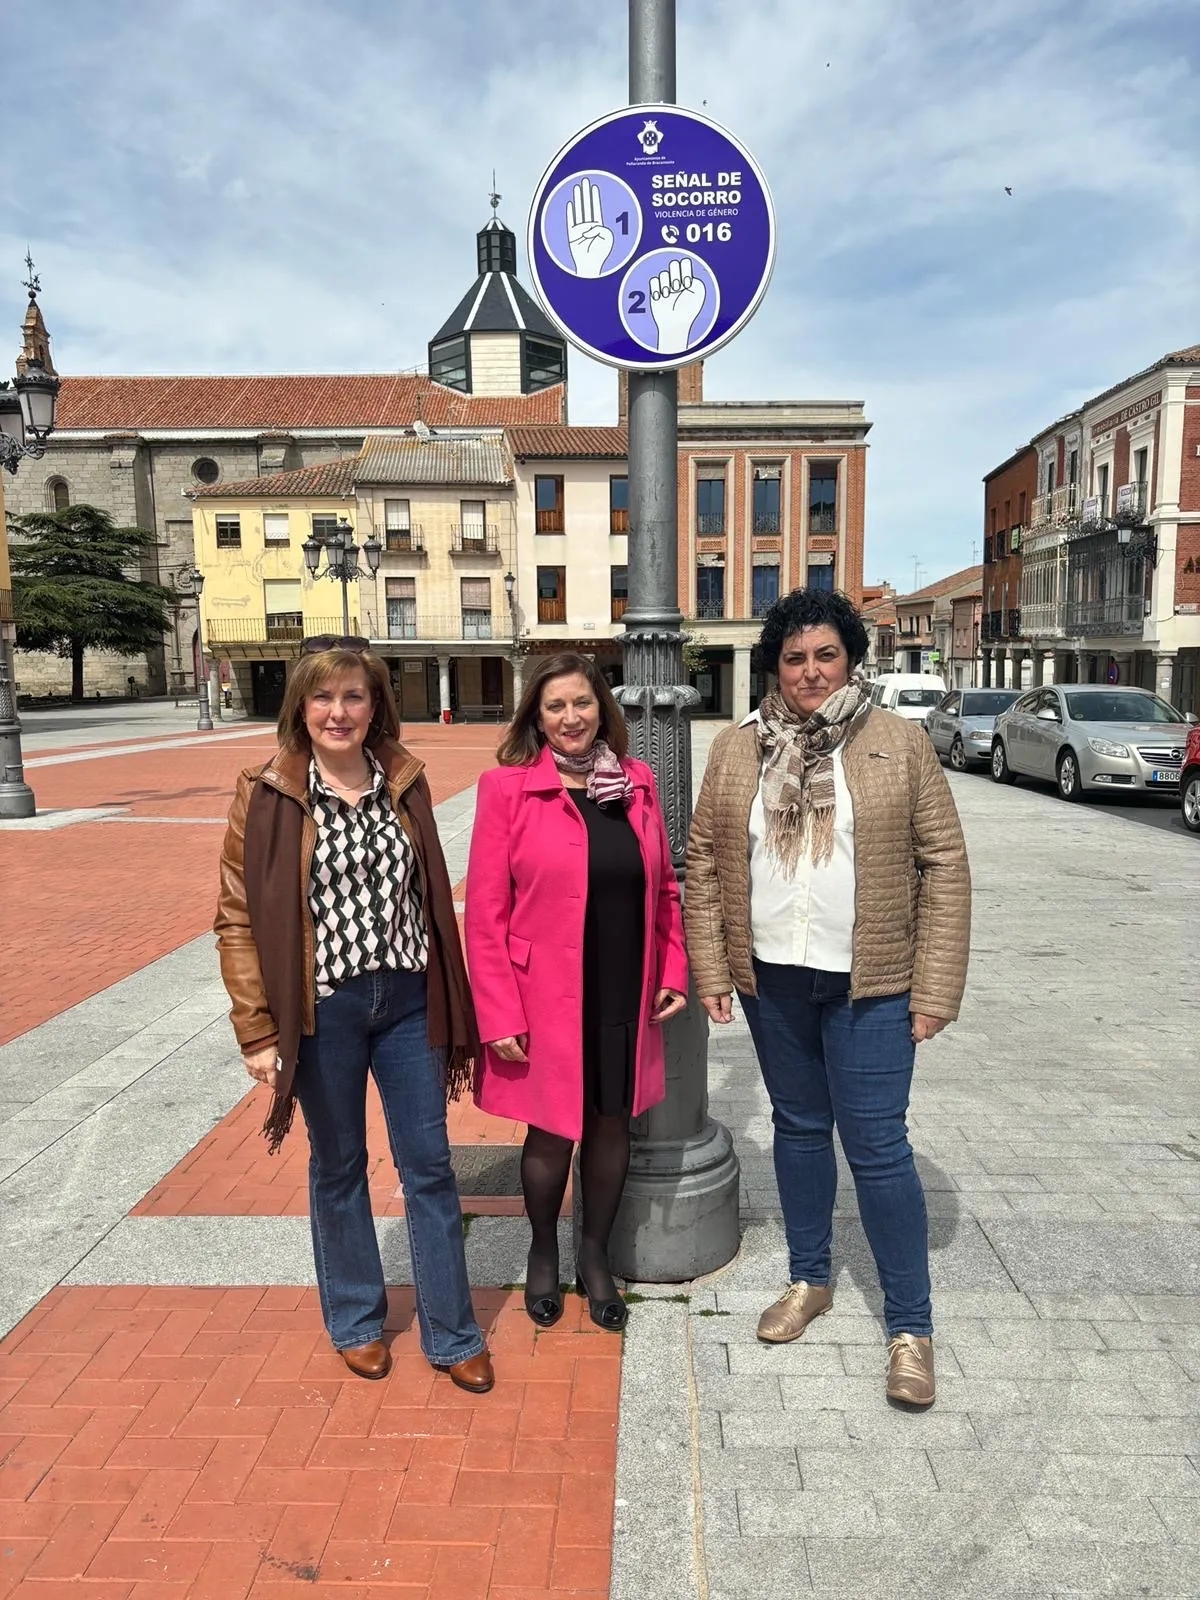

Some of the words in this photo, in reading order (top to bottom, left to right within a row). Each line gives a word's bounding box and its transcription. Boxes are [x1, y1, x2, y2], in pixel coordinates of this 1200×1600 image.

[652, 171, 712, 188] SEÑAL
[718, 172, 741, 186] DE
[652, 190, 741, 207] SOCORRO
[655, 210, 694, 218] VIOLENCIA
[696, 209, 706, 217] DE
[708, 207, 739, 217] GÉNERO
[616, 211, 628, 235] 1
[686, 222, 732, 242] 016
[628, 290, 646, 314] 2
[1128, 399, 1150, 418] CASTRO
[1159, 772, 1180, 780] 8806
